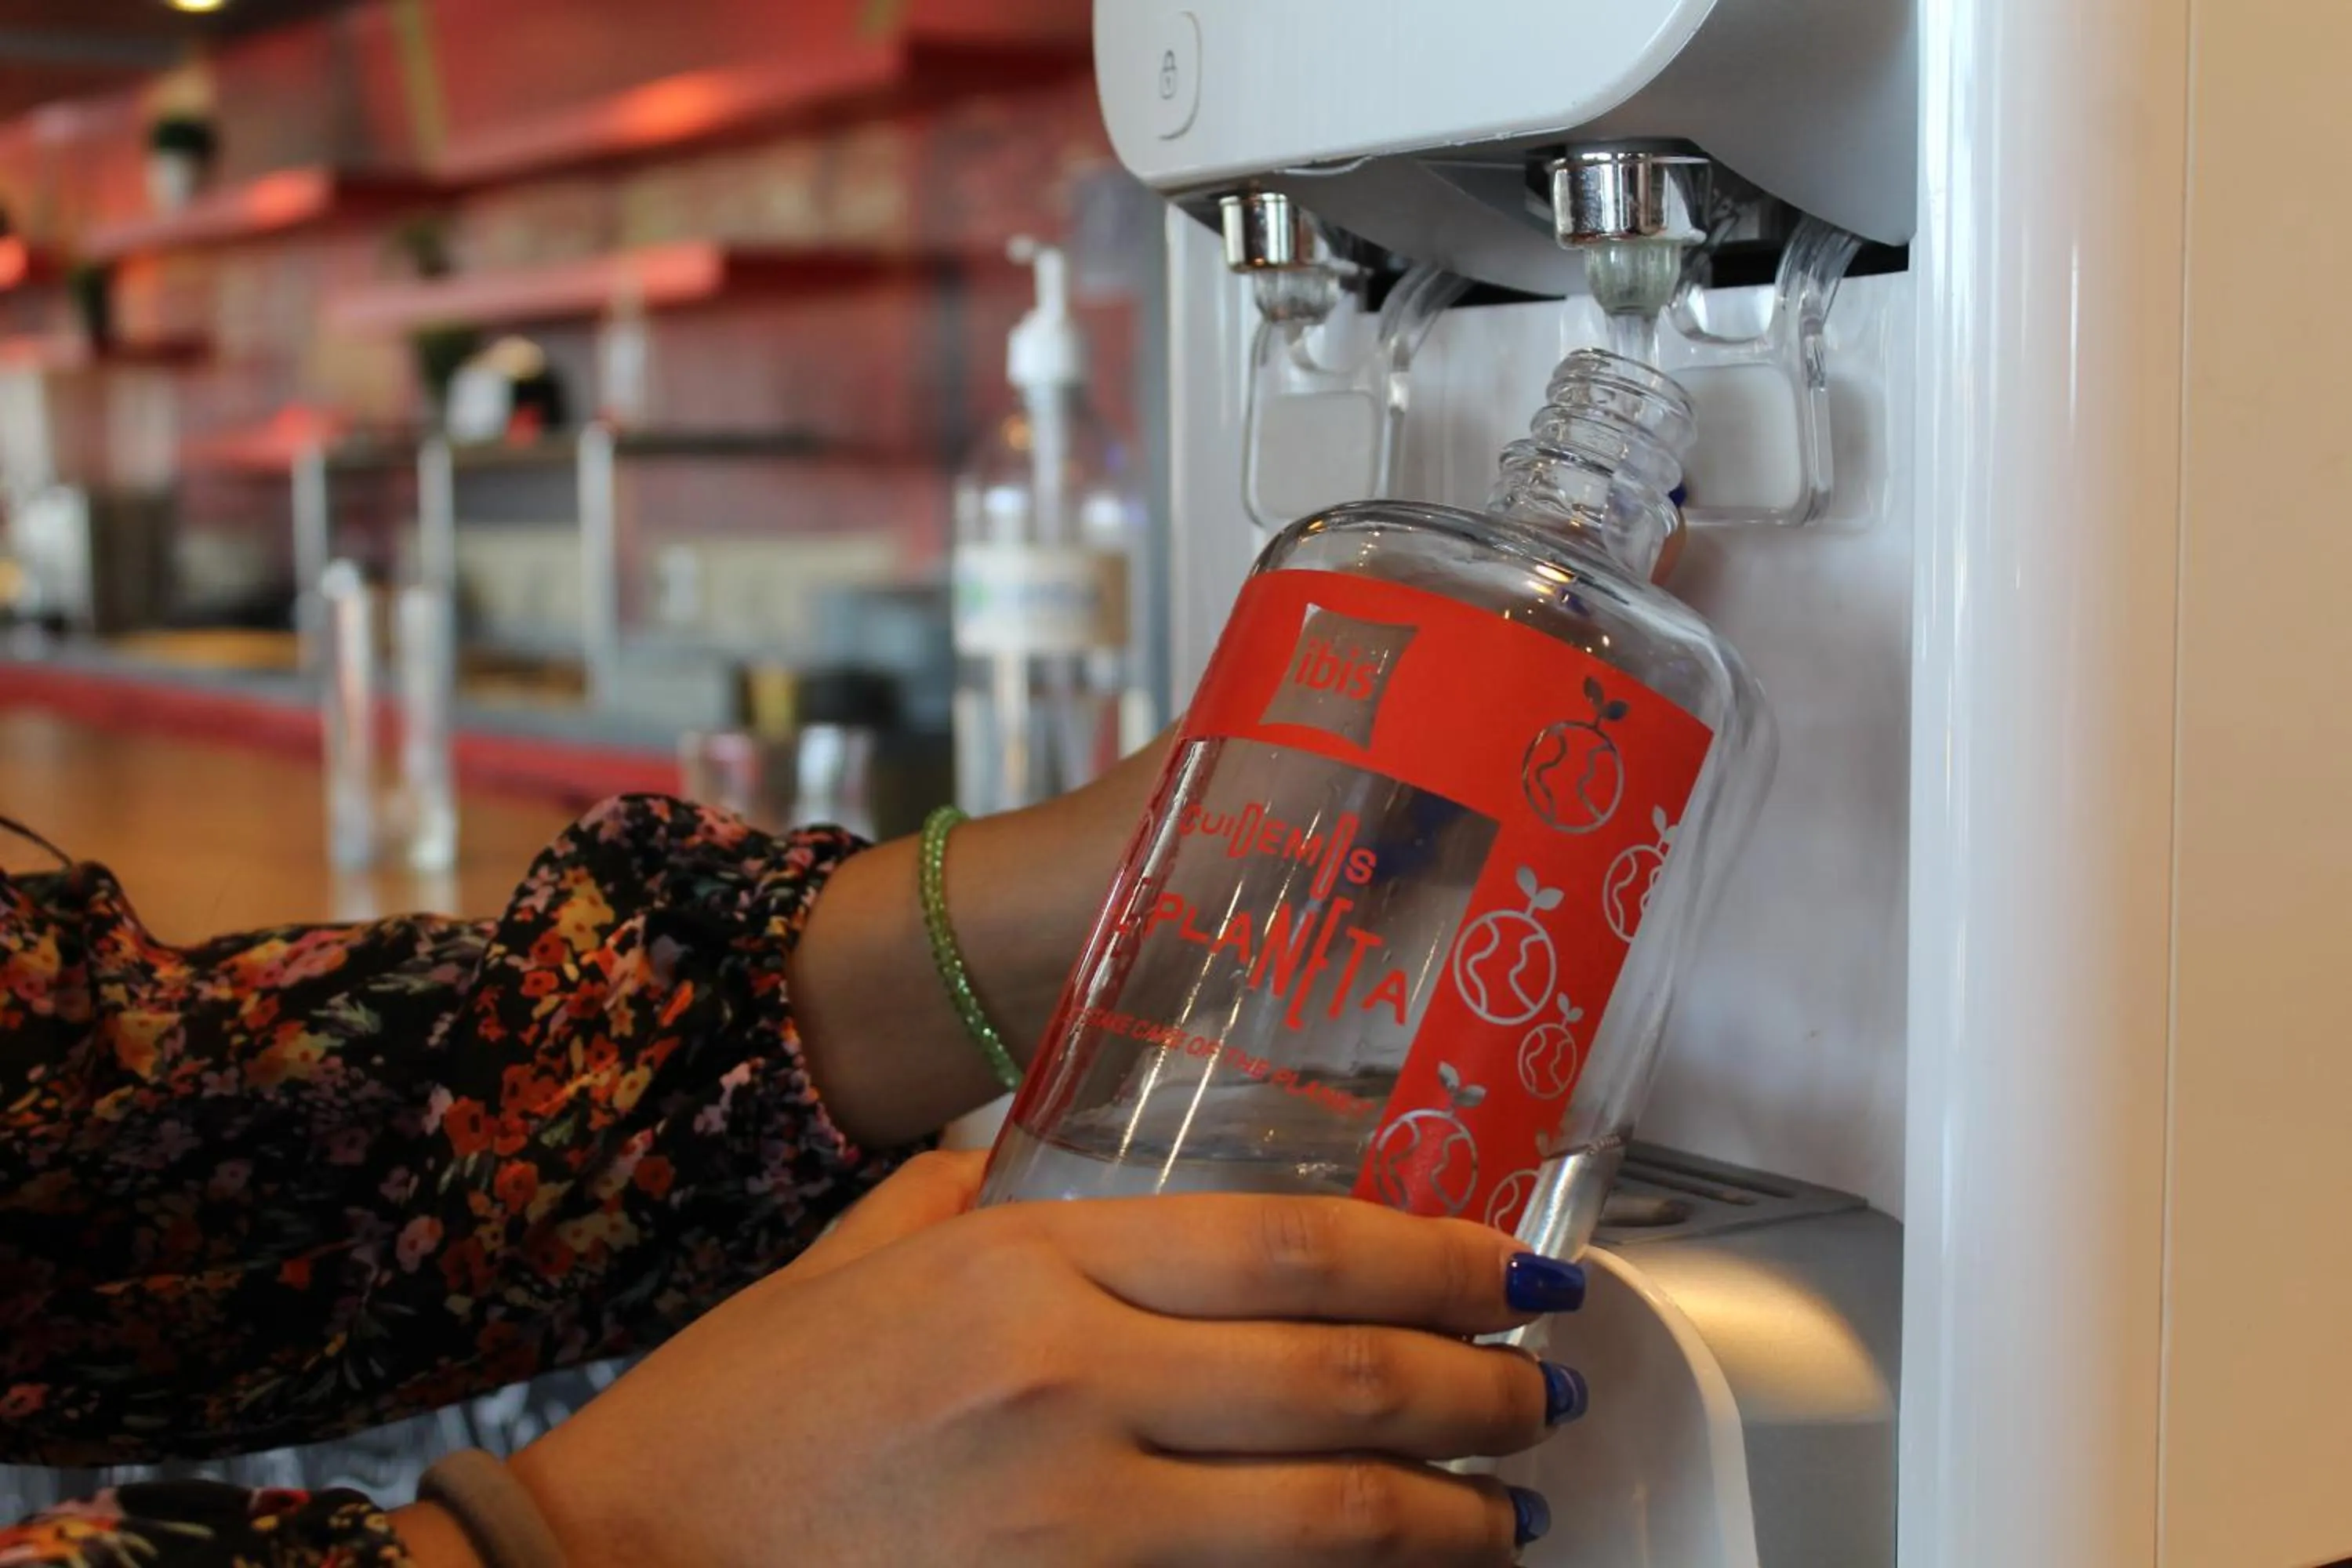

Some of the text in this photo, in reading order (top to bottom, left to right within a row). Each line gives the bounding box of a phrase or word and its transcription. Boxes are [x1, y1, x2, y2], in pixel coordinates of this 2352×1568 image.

[1294, 638, 1374, 699] ibis
[1178, 802, 1377, 901] CUIDEMOS
[1144, 891, 1406, 1032] PLANETA
